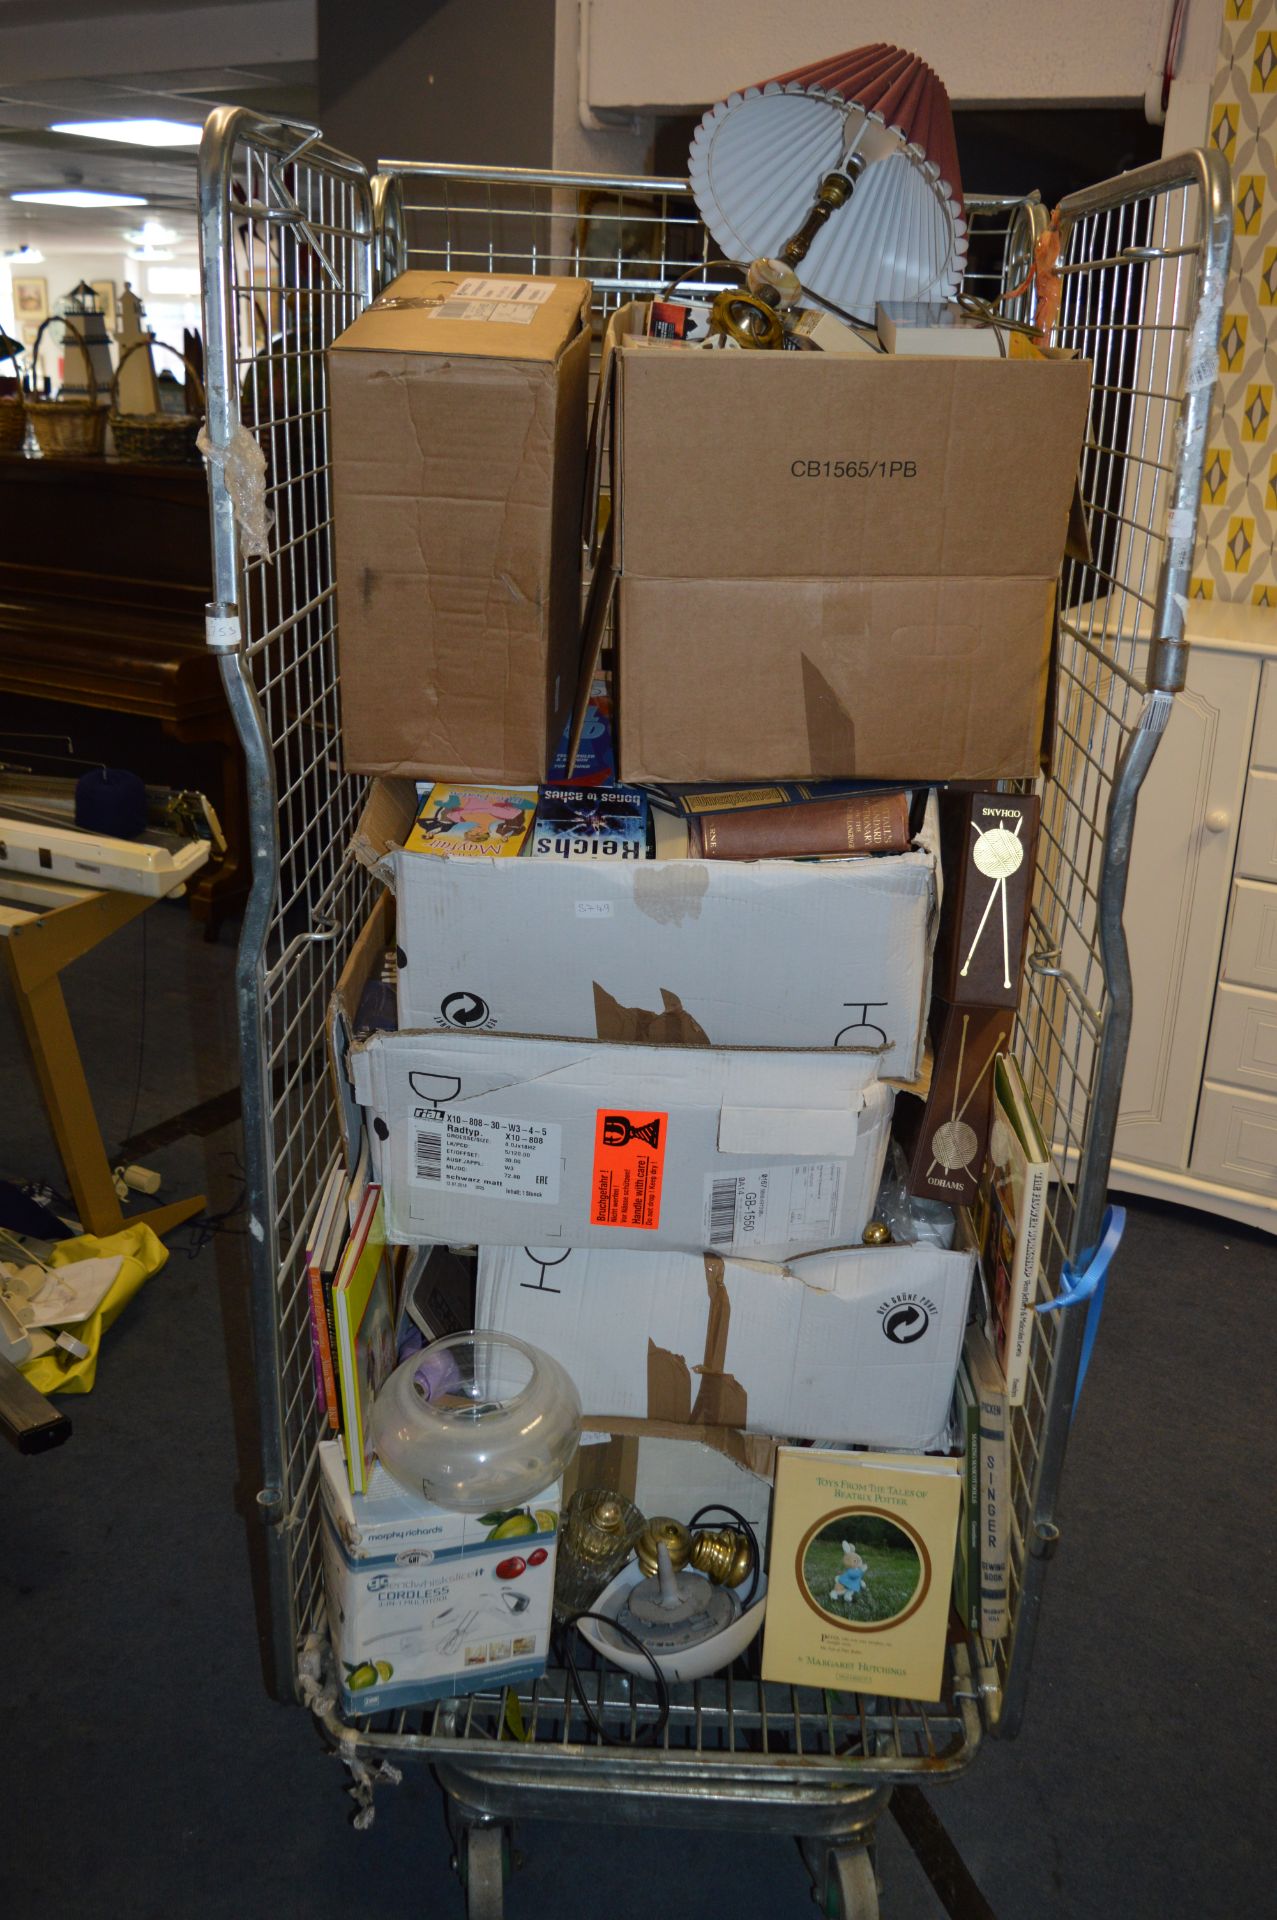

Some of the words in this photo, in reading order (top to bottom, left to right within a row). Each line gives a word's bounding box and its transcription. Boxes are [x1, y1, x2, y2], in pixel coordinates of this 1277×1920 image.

[791, 460, 917, 478] CB1565/1PB
[544, 790, 584, 803] ashes
[586, 792, 598, 801] to
[601, 792, 641, 806] bones
[982, 807, 1021, 818] ODHAMS
[537, 838, 640, 860] Reichs
[447, 1124, 484, 1138] Radtyp.
[637, 1160, 645, 1178] care
[446, 1174, 480, 1184] schwarz
[484, 1179, 503, 1187] matt
[634, 1179, 645, 1197] with
[927, 1177, 965, 1191] ODHAMS
[597, 1175, 609, 1222] Bruchgefahr
[632, 1198, 643, 1225] Handle
[744, 1192, 757, 1232] GB-1550
[876, 1302, 890, 1315] DER
[891, 1292, 917, 1304] GRÜNE
[919, 1296, 938, 1315] PUNKT
[816, 1477, 839, 1489] TOYS
[841, 1480, 868, 1492] FROM
[887, 1486, 915, 1497] TALES
[834, 1488, 872, 1501] BEATRIX
[874, 1494, 908, 1506] POTTER
[987, 1456, 997, 1548] SINGER
[368, 1531, 404, 1542] morphy
[405, 1526, 443, 1537] richards
[984, 1571, 1003, 1582] BOOK
[378, 1587, 450, 1601] CORDLESS
[806, 1656, 855, 1671] MARGARET
[858, 1663, 907, 1676] HUTCHINGS
